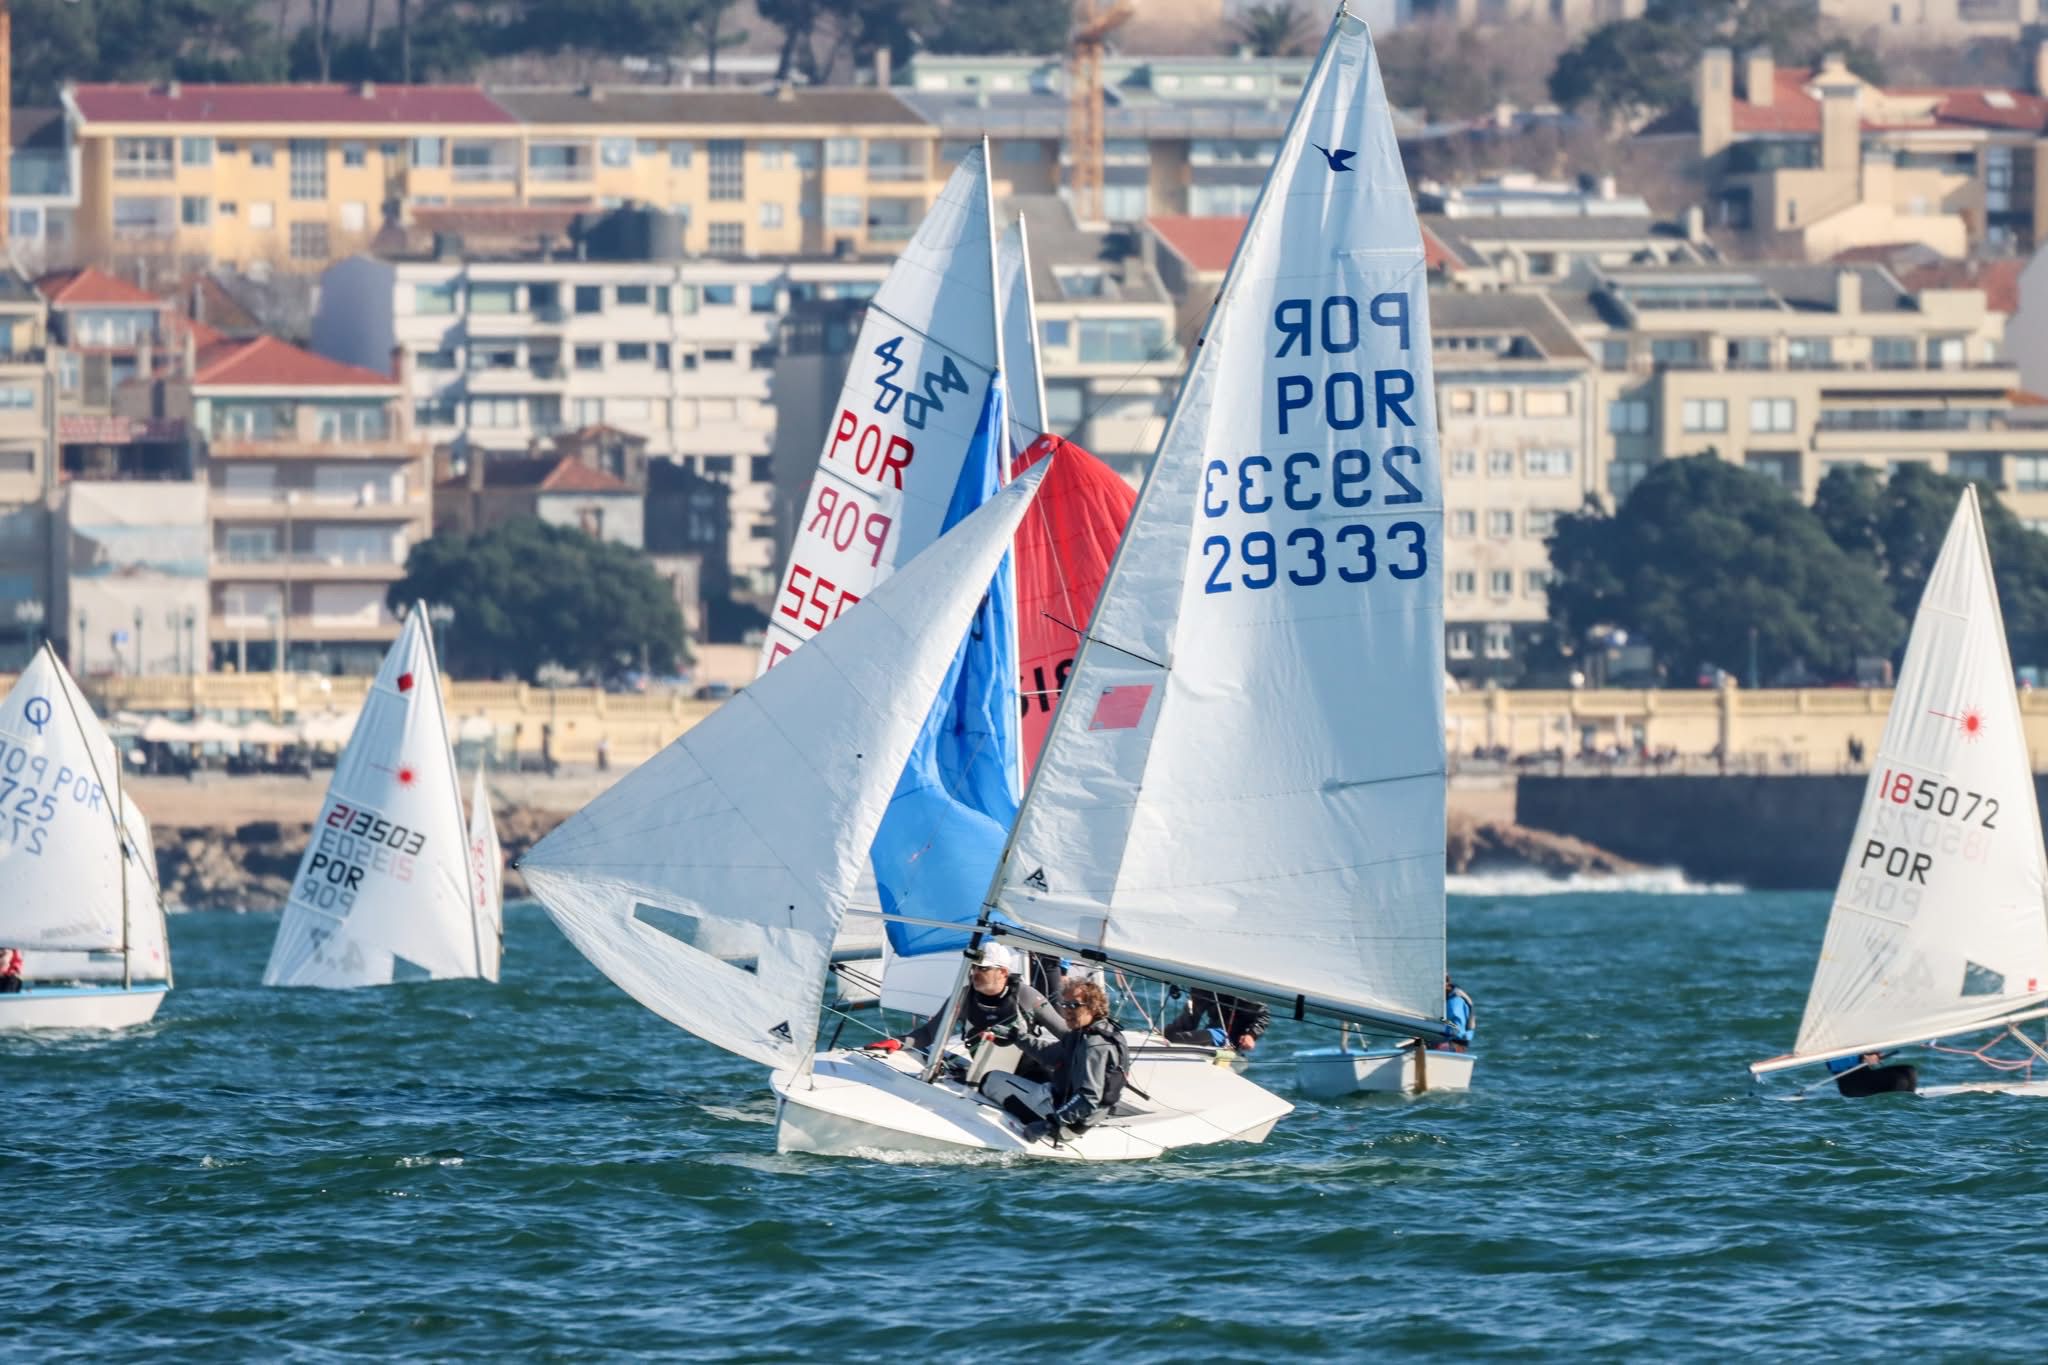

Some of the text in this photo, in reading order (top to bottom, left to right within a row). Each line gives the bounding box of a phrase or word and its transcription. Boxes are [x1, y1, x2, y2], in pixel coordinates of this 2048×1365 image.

[1277, 368, 1416, 435] POR
[828, 409, 915, 491] POR
[1202, 521, 1428, 595] 29333
[52, 765, 104, 813] POR
[1879, 768, 2000, 830] 185072
[326, 803, 427, 856] 213503
[308, 853, 365, 892] POR
[1860, 838, 1933, 886] POR
